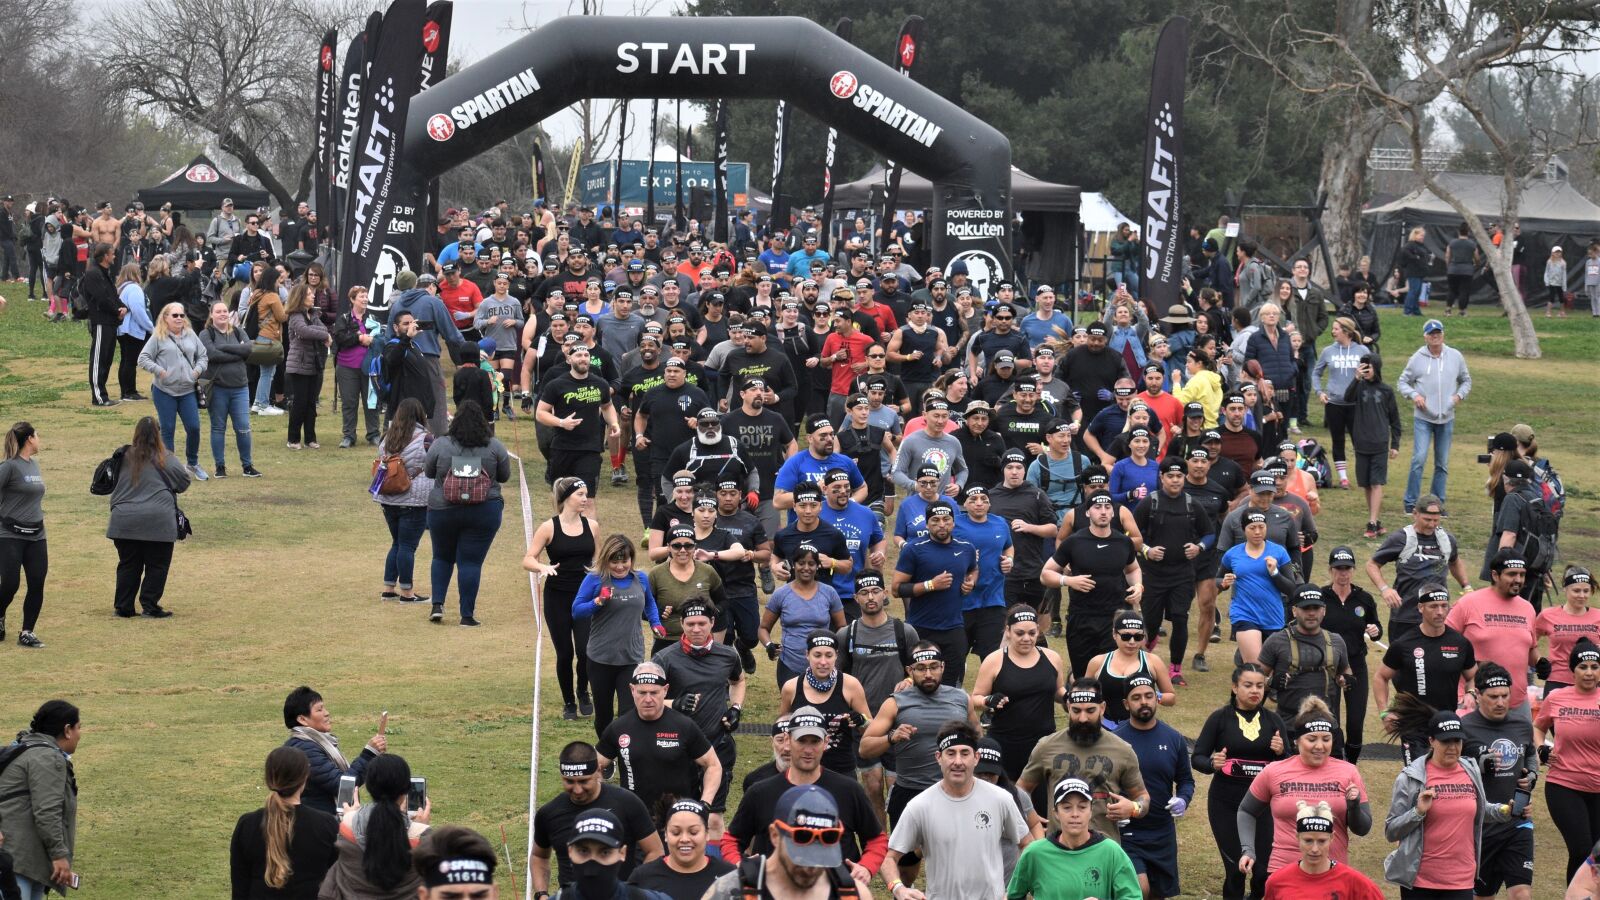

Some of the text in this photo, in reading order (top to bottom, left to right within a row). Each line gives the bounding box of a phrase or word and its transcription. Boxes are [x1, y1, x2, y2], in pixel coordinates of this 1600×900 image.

[615, 42, 756, 75] START
[420, 53, 434, 93] NE
[321, 72, 330, 116] LINE
[452, 68, 541, 130] SPARTAN
[852, 84, 942, 148] SPARTAN
[351, 110, 390, 254] CRAFT
[587, 177, 606, 191] EXPLORE
[640, 176, 716, 190] EXPOR
[360, 132, 397, 258] FUNCTIONAL SPORTSWEAR
[404, 206, 415, 215] BY
[947, 209, 1004, 218] POWERED BY
[1146, 135, 1173, 280] CRAFT
[946, 221, 1005, 237] Rakuten
[1160, 223, 1179, 283] FUNCTIONAL
[488, 305, 513, 317] BEAST
[1334, 361, 1360, 369] BEAR
[738, 425, 773, 435] DON'T
[911, 514, 926, 526] LOS
[1415, 659, 1427, 696] SPARTAN
[801, 716, 822, 724] SPARTAN
[983, 748, 1001, 758] SPARTAN
[620, 747, 635, 790] SPARTAN
[1279, 781, 1341, 794] SPARTANSGX
[679, 801, 703, 811] SPARTAN
[582, 818, 614, 830] SPARTAN
[1308, 818, 1330, 826] SPARTAN
[450, 860, 489, 871] SPARTAN
[447, 872, 485, 882] 11614
